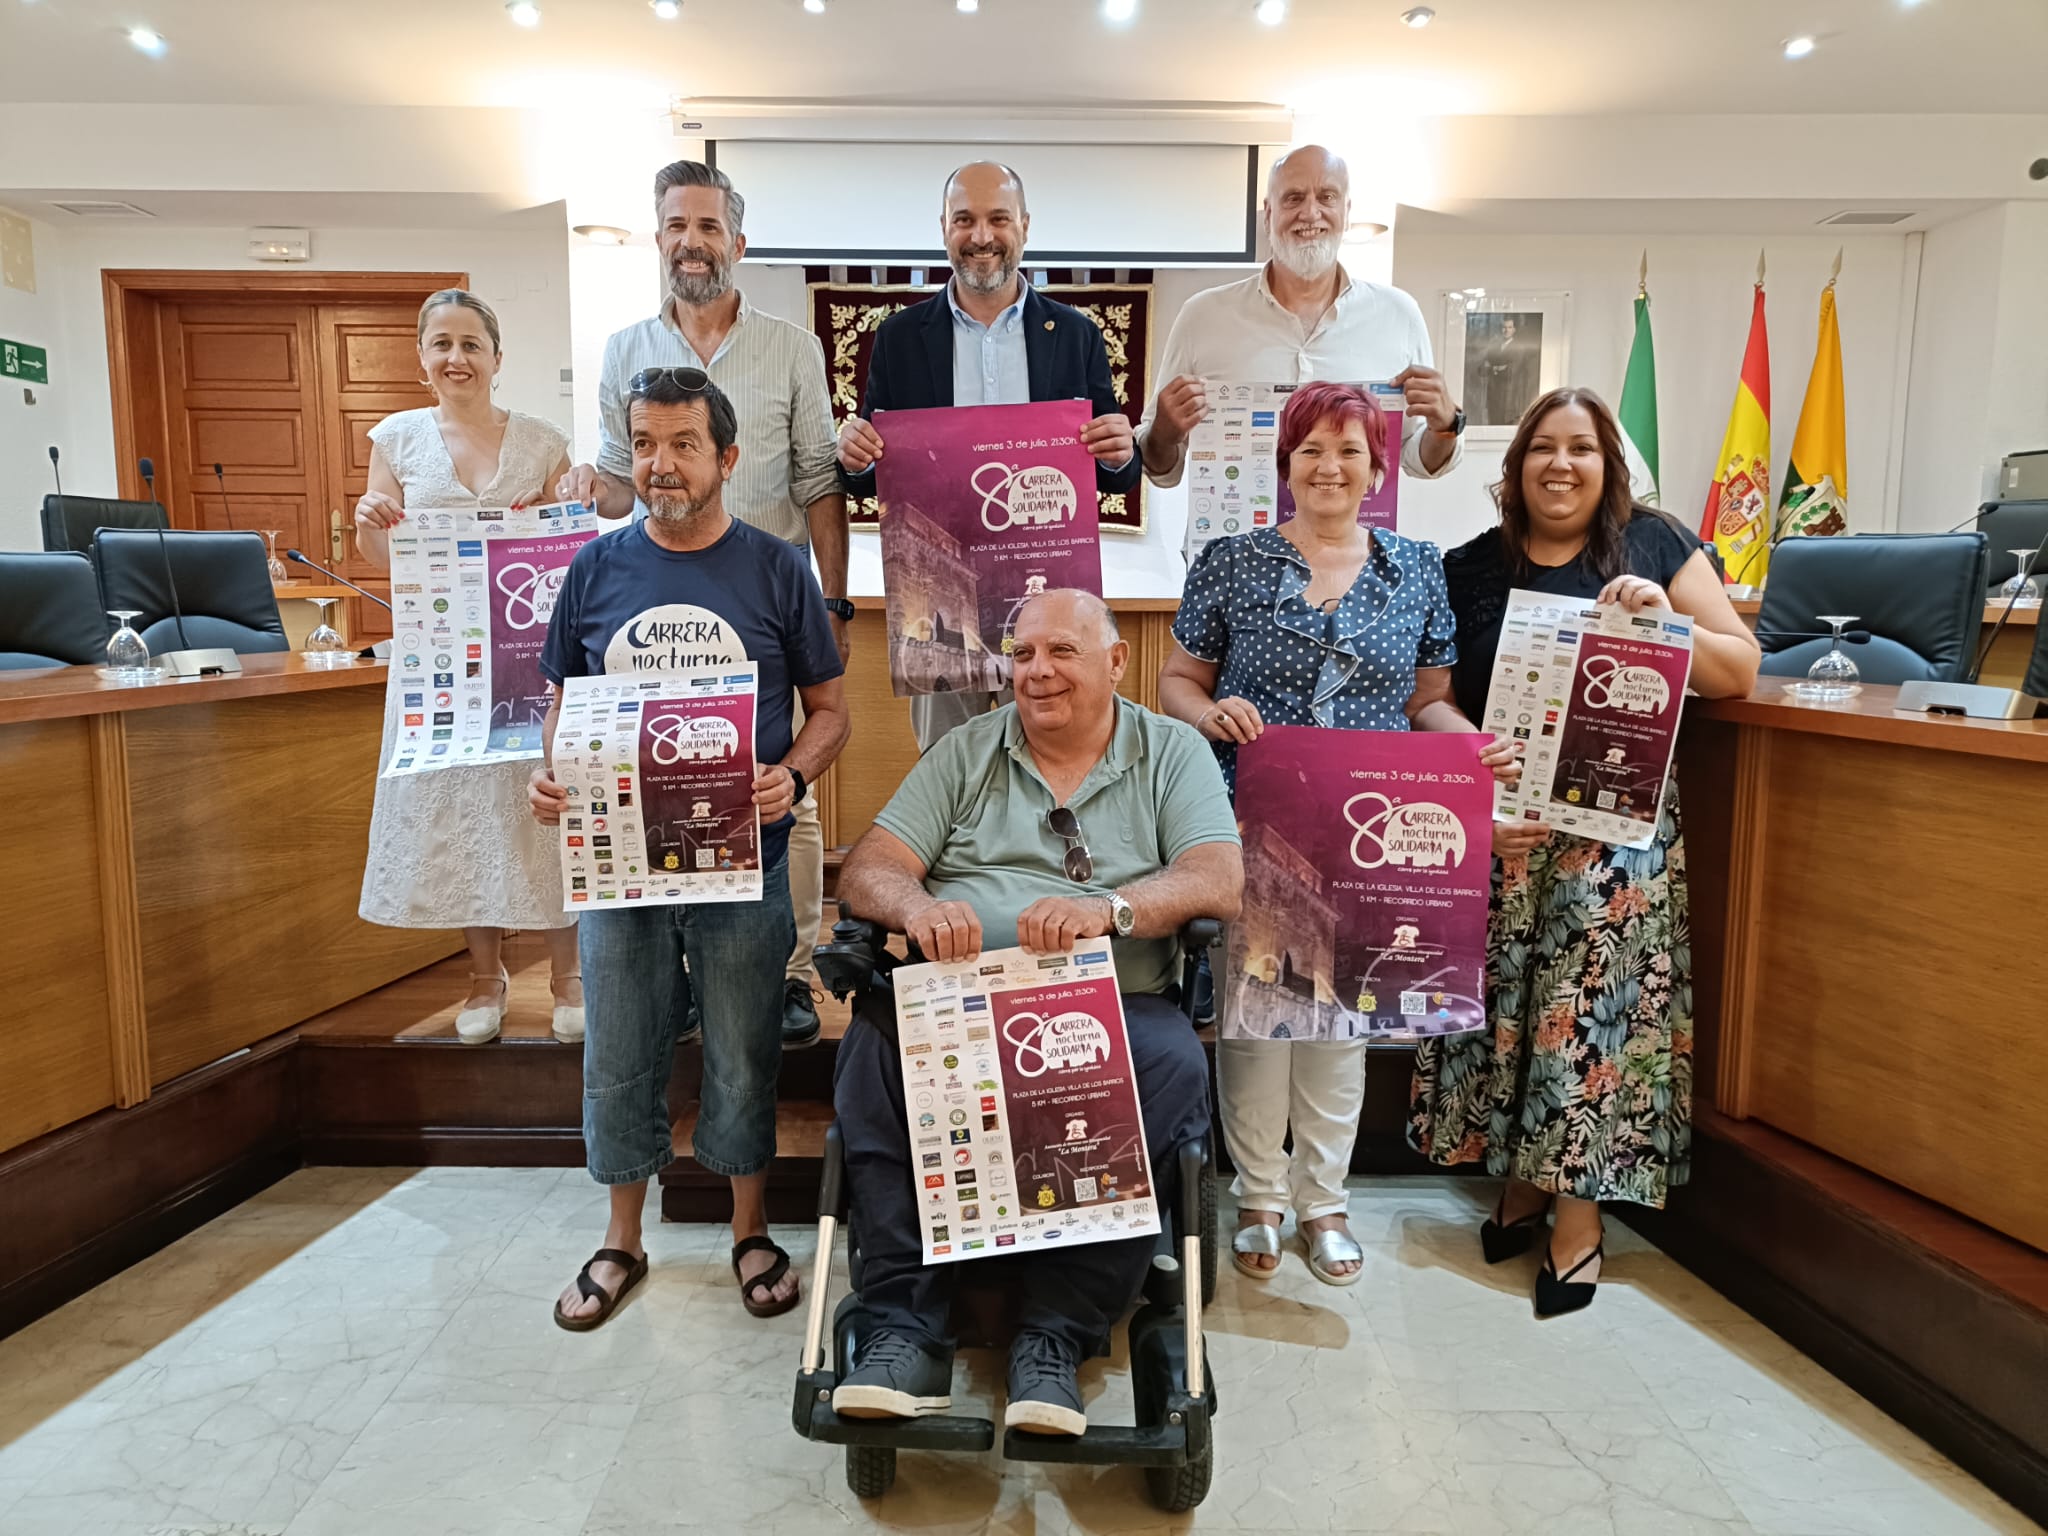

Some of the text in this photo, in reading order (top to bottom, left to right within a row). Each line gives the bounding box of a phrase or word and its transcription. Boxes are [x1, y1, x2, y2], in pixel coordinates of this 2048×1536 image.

[972, 443, 1003, 452] viernes
[1007, 441, 1013, 449] 3
[1016, 440, 1027, 448] de
[1020, 474, 1062, 489] CARRERA
[1023, 488, 1068, 499] nocturna
[1013, 500, 1058, 513] SOLIDARIA
[627, 620, 721, 648] CARRERA
[1598, 642, 1620, 650] viernes
[632, 647, 732, 670] nocturna
[1624, 671, 1661, 682] CARRERA
[1612, 690, 1651, 703] SOLIDARIA
[1624, 684, 1663, 696] nocturna
[690, 721, 727, 731] CARRERA
[681, 740, 721, 749] SOLIDARIA
[1350, 770, 1386, 779] viernes
[1390, 771, 1397, 780] 3
[1401, 772, 1415, 780] de
[1400, 810, 1451, 826] CARRERA
[1402, 826, 1456, 840] nocturna
[1388, 840, 1442, 856] SOLIDARIA
[1333, 881, 1353, 889] PLAZA
[1384, 897, 1423, 906] RECORRIDO
[1426, 898, 1453, 908] URBANO
[1011, 996, 1036, 1005] viernes
[1052, 1019, 1093, 1035] CARRERA
[1056, 1032, 1100, 1045] nocturna
[1046, 1043, 1091, 1058] SOLIDARIA
[1052, 1094, 1086, 1104] RECORRIDO
[1088, 1091, 1110, 1099] URBANO
